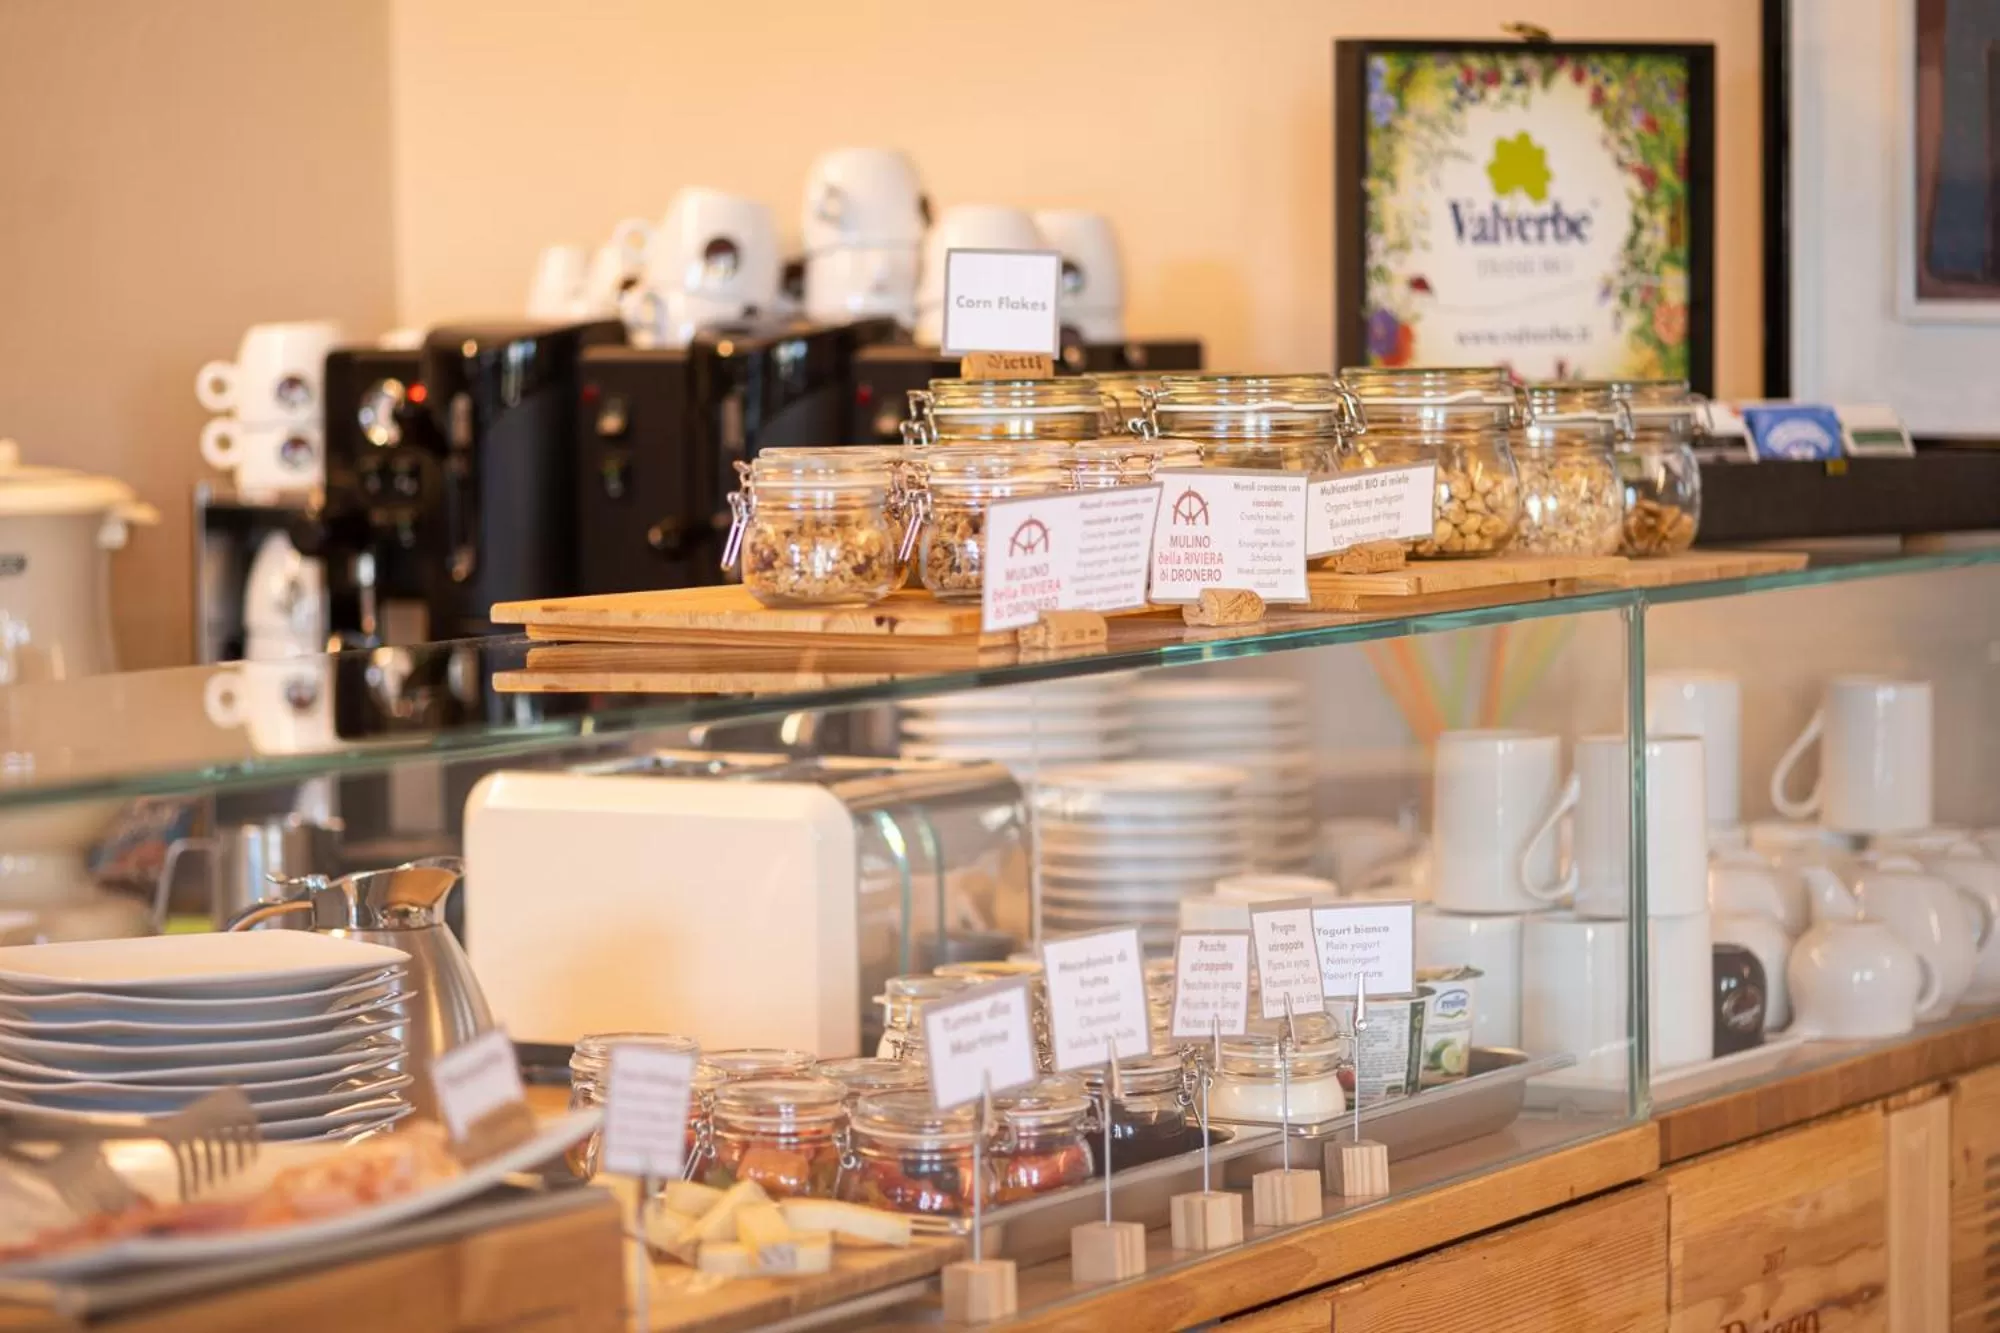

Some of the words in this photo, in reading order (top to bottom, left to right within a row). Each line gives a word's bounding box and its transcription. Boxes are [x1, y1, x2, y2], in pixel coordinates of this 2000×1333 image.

[1447, 199, 1592, 245] Valverbe
[956, 295, 992, 309] Corn
[998, 295, 1047, 312] Flakes
[1170, 535, 1211, 548] MULINO
[1158, 552, 1182, 565] della
[1184, 552, 1224, 565] RIVIERA
[1005, 563, 1049, 580] MULINO
[1159, 568, 1169, 581] di
[1171, 569, 1223, 582] DRONERO
[1019, 577, 1061, 596] RIVIERA
[1007, 596, 1058, 618] DRONERO
[1316, 926, 1351, 937] Yogurt
[1354, 924, 1389, 934] bianco
